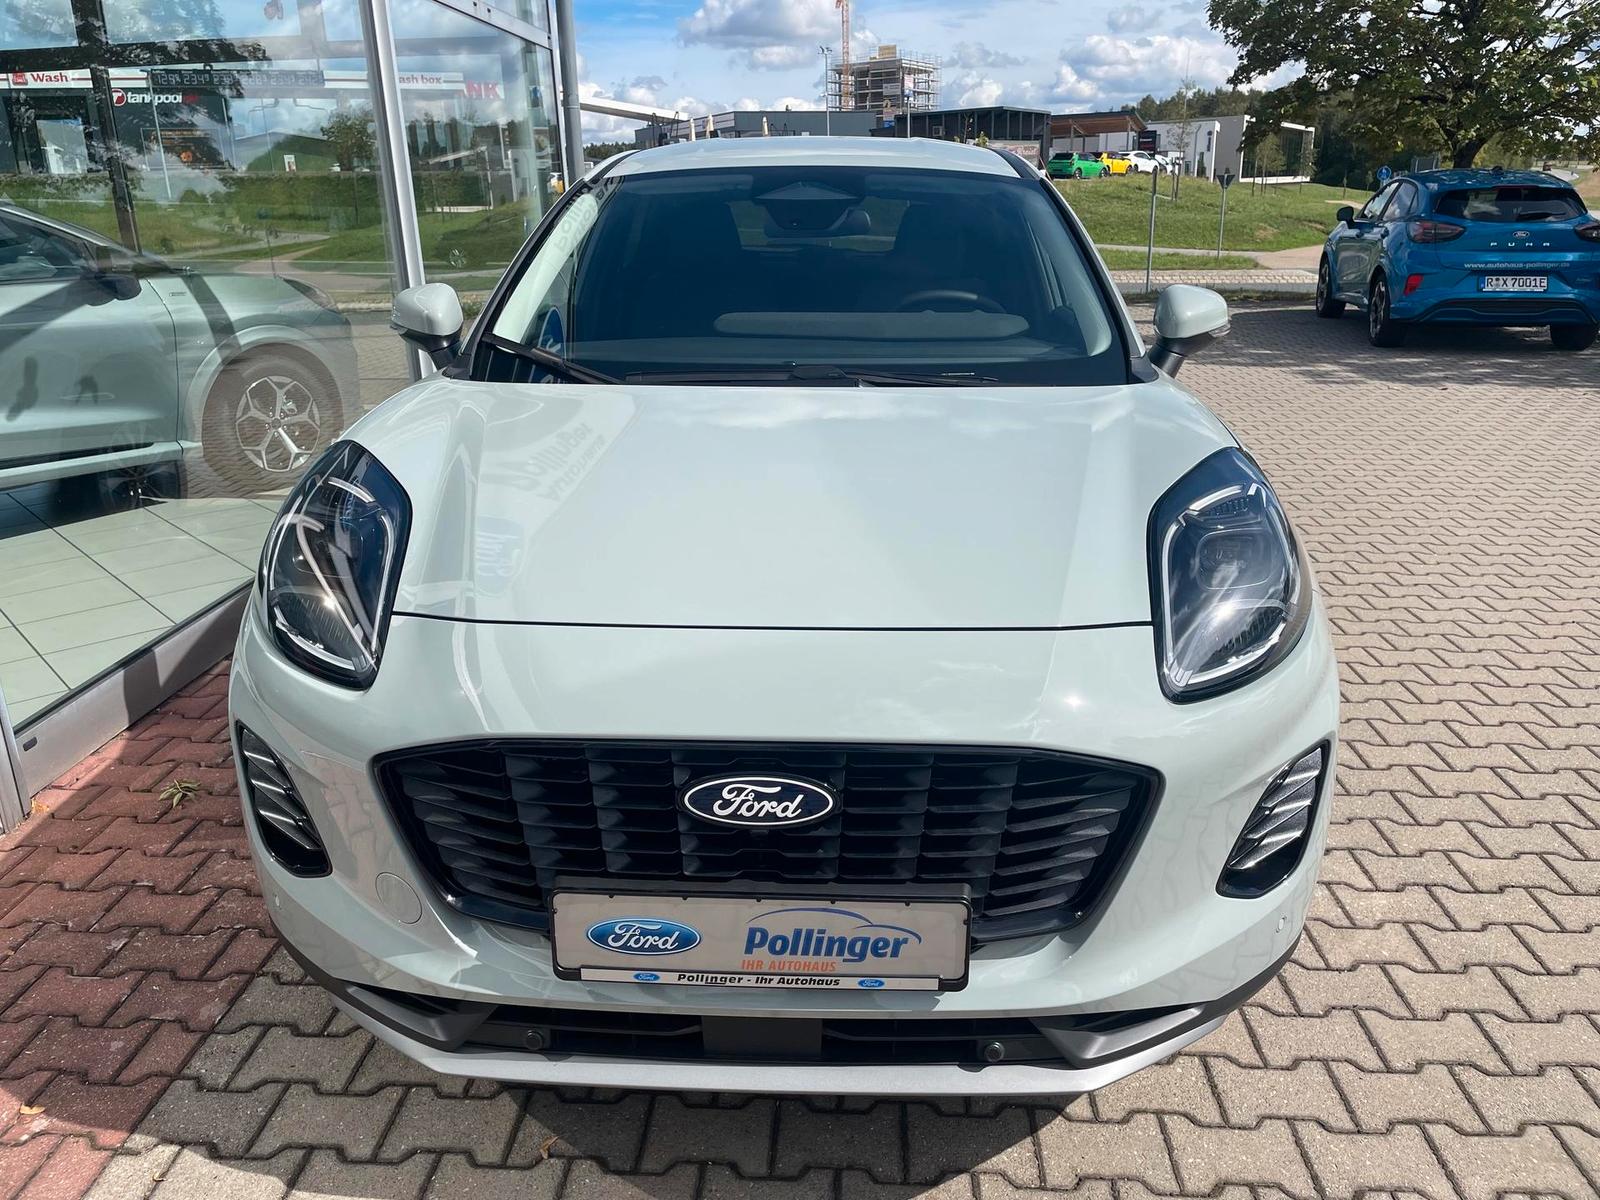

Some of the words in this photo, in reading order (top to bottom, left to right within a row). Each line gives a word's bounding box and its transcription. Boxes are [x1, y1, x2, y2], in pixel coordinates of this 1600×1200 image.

[31, 73, 69, 82] Wash
[400, 74, 418, 84] ash
[421, 74, 441, 84] box
[1486, 277, 1494, 287] R
[1501, 277, 1509, 287] X
[1511, 277, 1547, 288] 7001E
[712, 783, 804, 818] Ford
[607, 922, 681, 950] Ford
[744, 926, 909, 963] Pollinger
[741, 959, 764, 971] IHR
[768, 960, 837, 972] AUTOHAUS
[677, 973, 744, 984] Pollinger
[755, 976, 774, 985] Ihr
[777, 976, 840, 987] Autohaus
